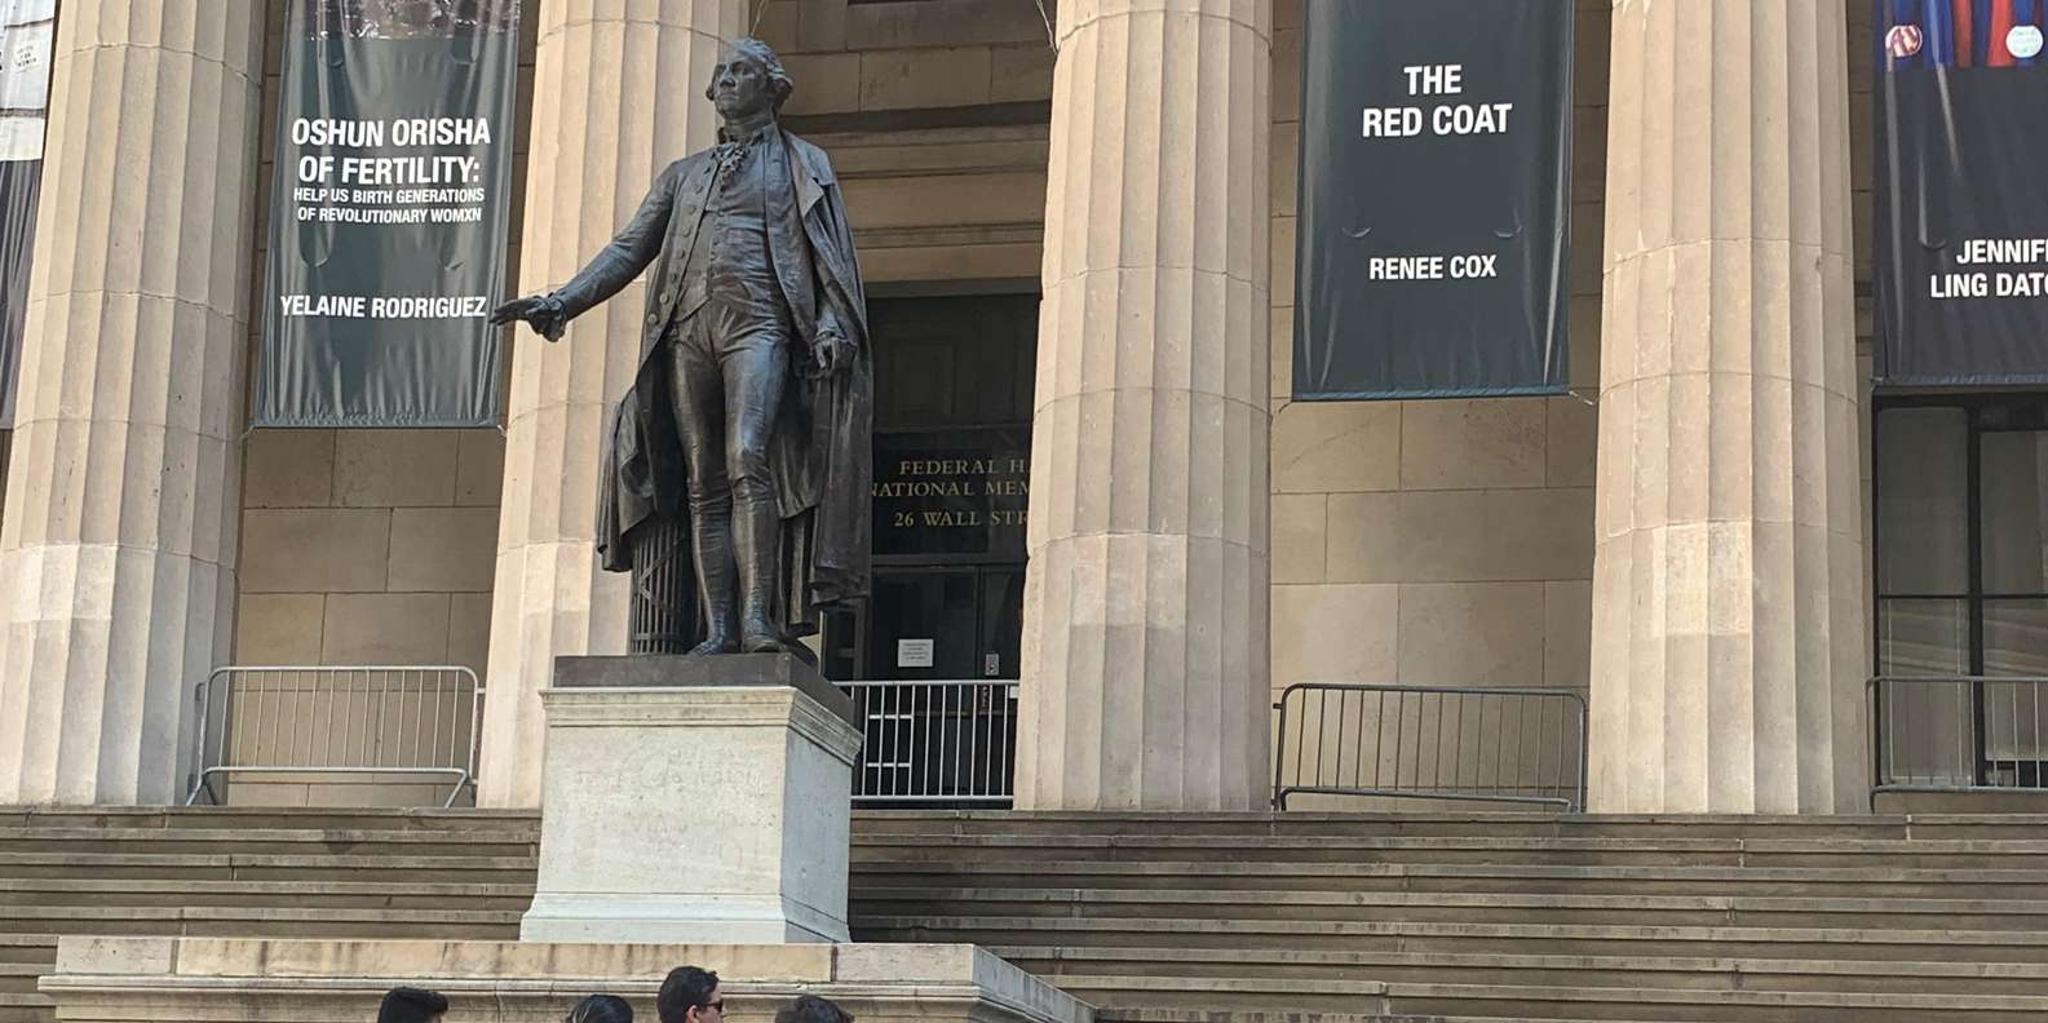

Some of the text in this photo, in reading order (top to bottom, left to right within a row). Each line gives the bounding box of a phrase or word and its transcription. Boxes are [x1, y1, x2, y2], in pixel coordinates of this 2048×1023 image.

[1403, 64, 1462, 96] THE
[292, 117, 491, 147] OSHUN ORISHA
[1362, 102, 1513, 138] RED COAT
[299, 155, 480, 185] OF FERTILITY:
[293, 187, 485, 204] HELP US BIRTH GENERATIONS
[297, 206, 482, 224] OF REVOLUTIONARY WOMXN
[1956, 239, 2048, 264] JENNIF
[1369, 254, 1497, 280] RENEE COX
[1930, 272, 2048, 298] LING DAT
[280, 295, 487, 319] YELAINE RODRIGUEZ
[900, 459, 999, 475] FEDERAL
[894, 511, 914, 527] 26
[923, 510, 980, 527] WALL
